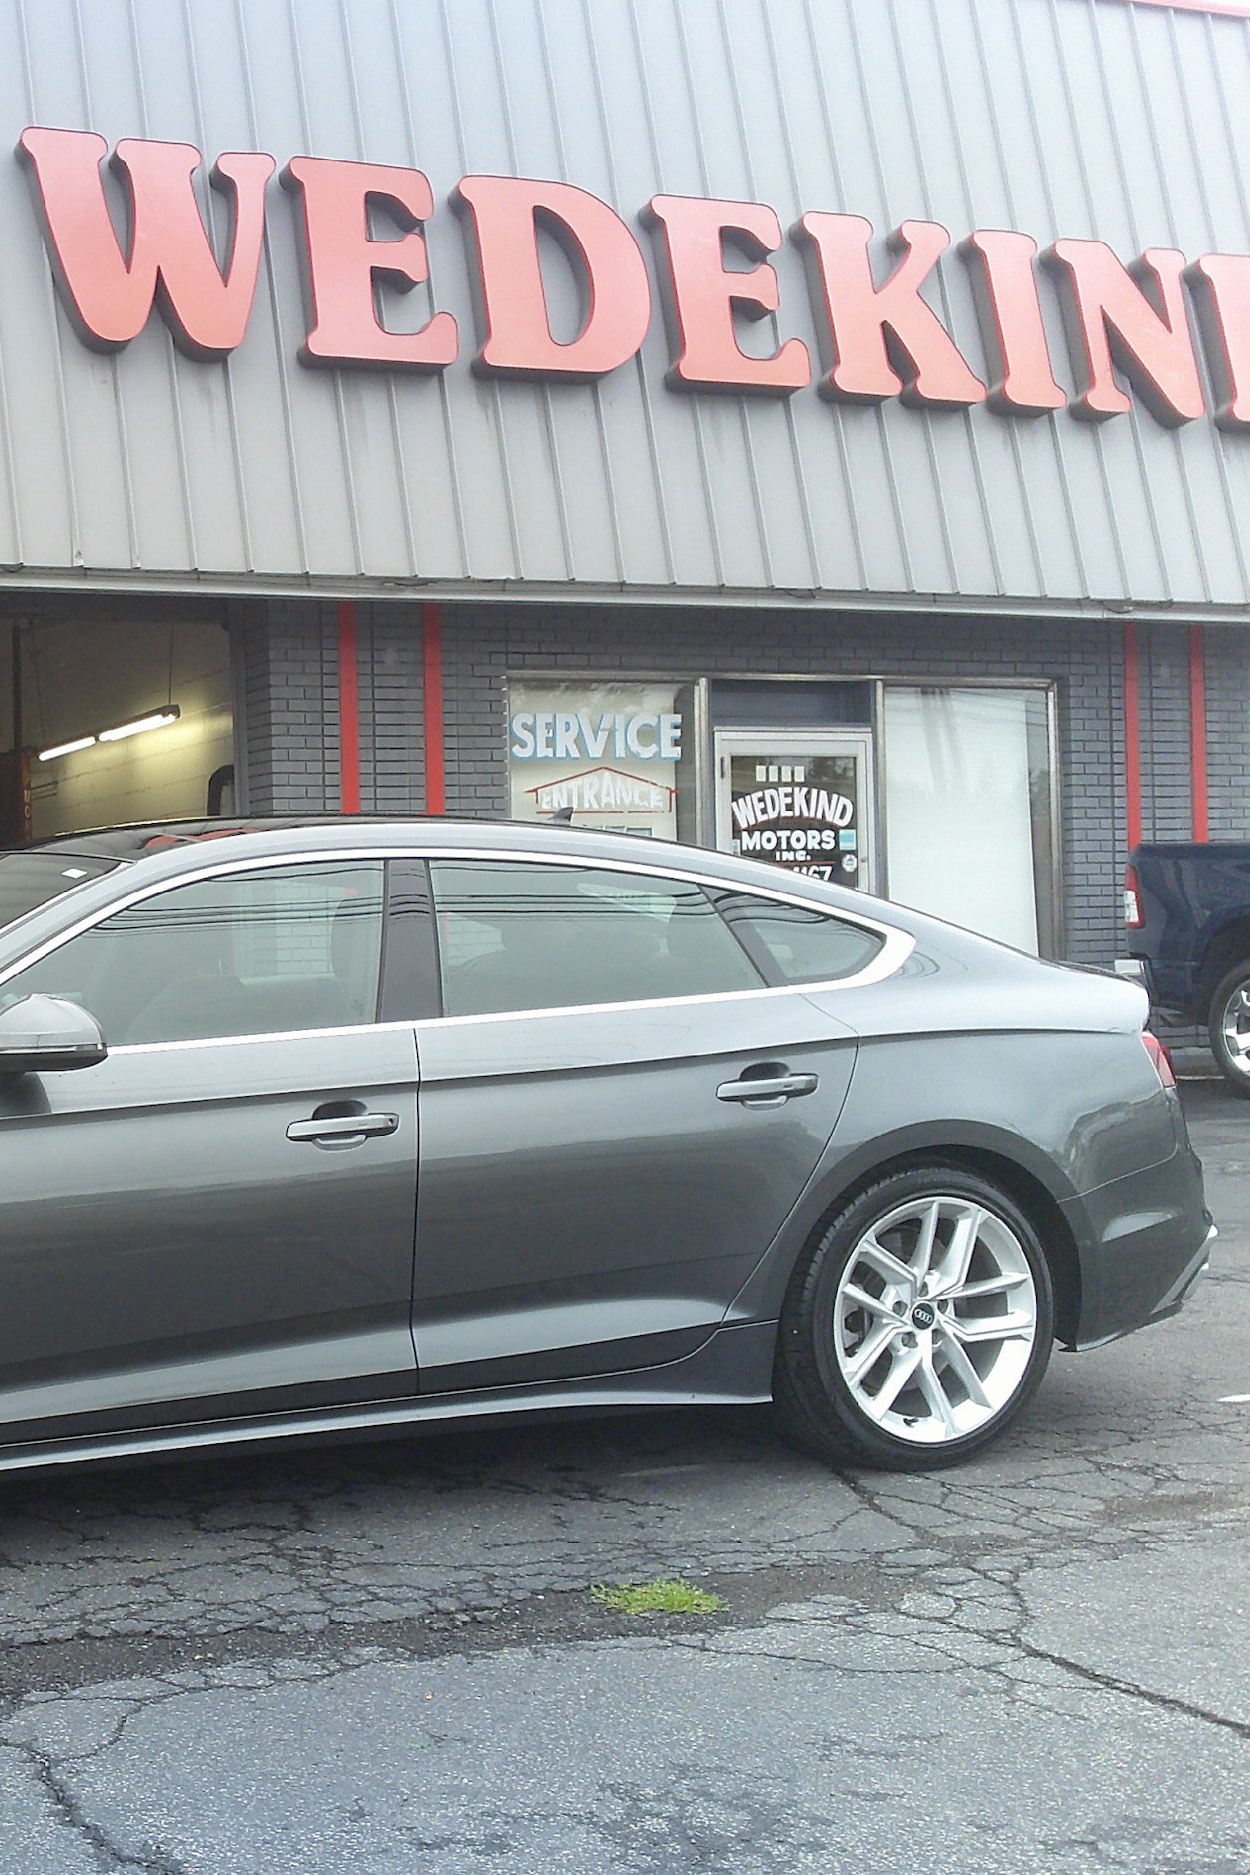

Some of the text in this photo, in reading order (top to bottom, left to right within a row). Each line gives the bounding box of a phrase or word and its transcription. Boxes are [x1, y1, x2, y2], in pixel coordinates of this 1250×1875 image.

[511, 712, 682, 760] SERVICE
[541, 772, 664, 810] ENTRANCE
[732, 787, 854, 829] WEDEKIND
[741, 829, 836, 851] MOTORS
[776, 850, 811, 862] INC.
